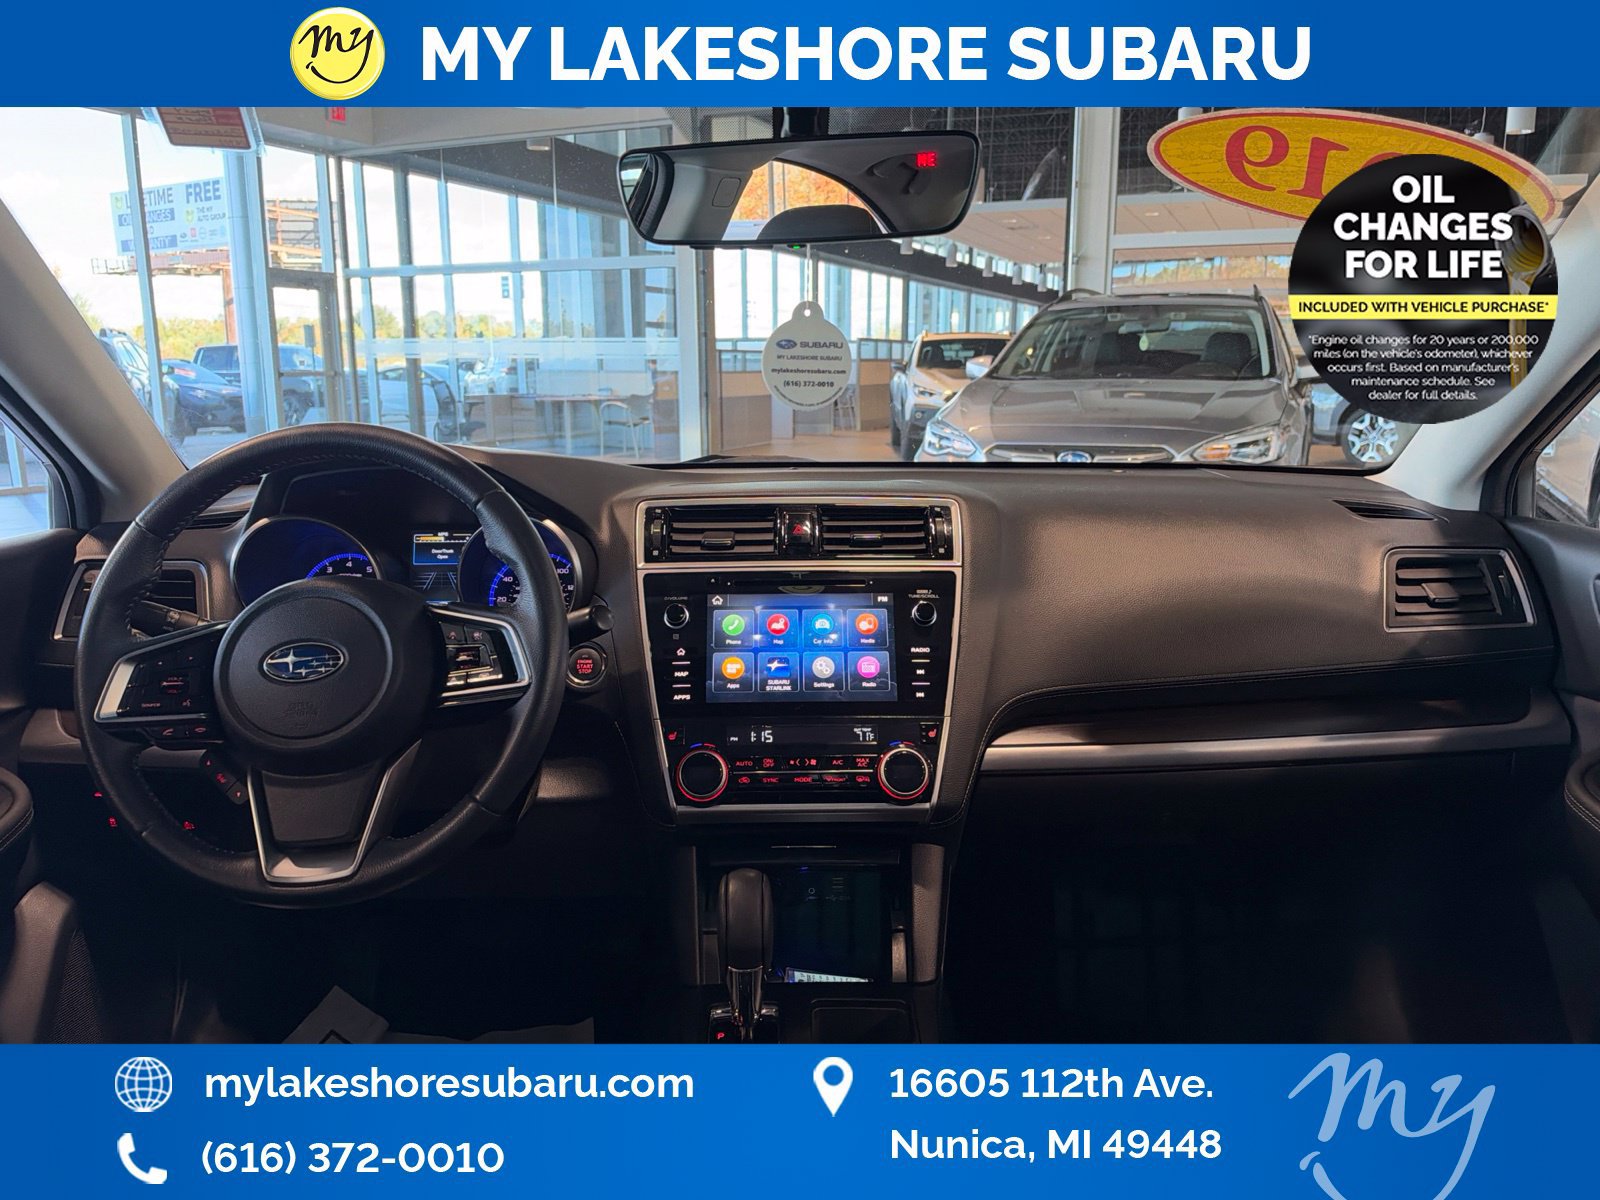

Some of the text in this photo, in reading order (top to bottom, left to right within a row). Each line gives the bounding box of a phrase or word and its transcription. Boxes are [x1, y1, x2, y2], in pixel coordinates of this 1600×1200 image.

[185, 179, 222, 204] FREE
[800, 341, 844, 349] SUBARU
[771, 367, 847, 375] mylakeshoresubaru.com
[783, 380, 801, 388] (616)
